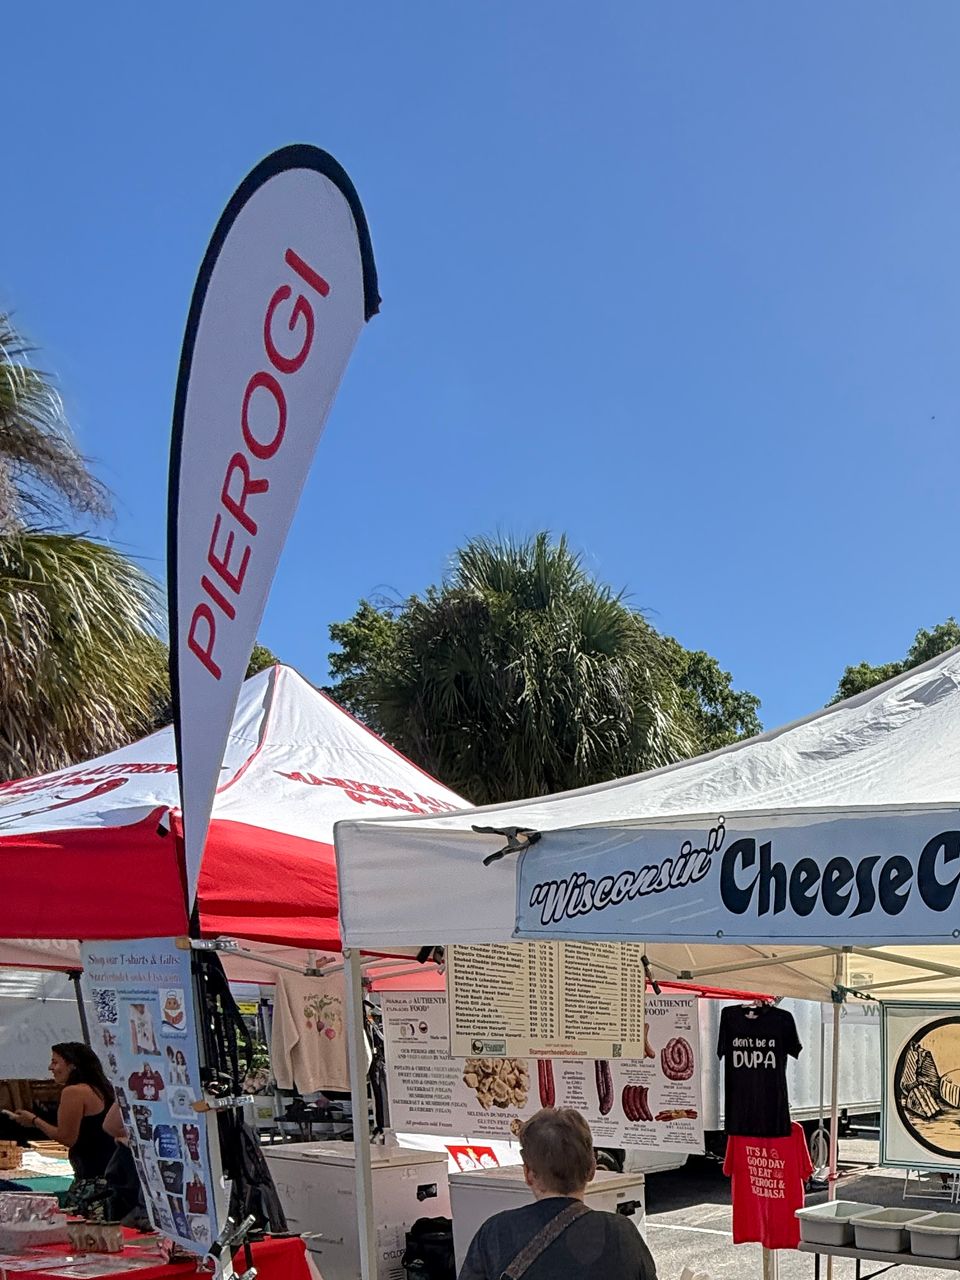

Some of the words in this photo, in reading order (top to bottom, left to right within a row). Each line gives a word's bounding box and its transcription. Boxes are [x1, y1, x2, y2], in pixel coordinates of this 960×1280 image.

[188, 248, 330, 680] PIEROGI
[529, 824, 724, 926] "Wisconsin"
[120, 954, 149, 965] T-shirts
[733, 1038, 753, 1048] don't
[756, 1038, 767, 1048] be
[769, 1040, 775, 1048] a
[733, 1051, 776, 1069] DUPA
[746, 1146, 760, 1156] IT'S
[762, 1148, 767, 1157] A
[747, 1156, 767, 1166] GOOD
[769, 1159, 785, 1169] DAY
[748, 1166, 757, 1175] TO
[758, 1168, 772, 1178] EAT
[778, 1180, 785, 1189] &
